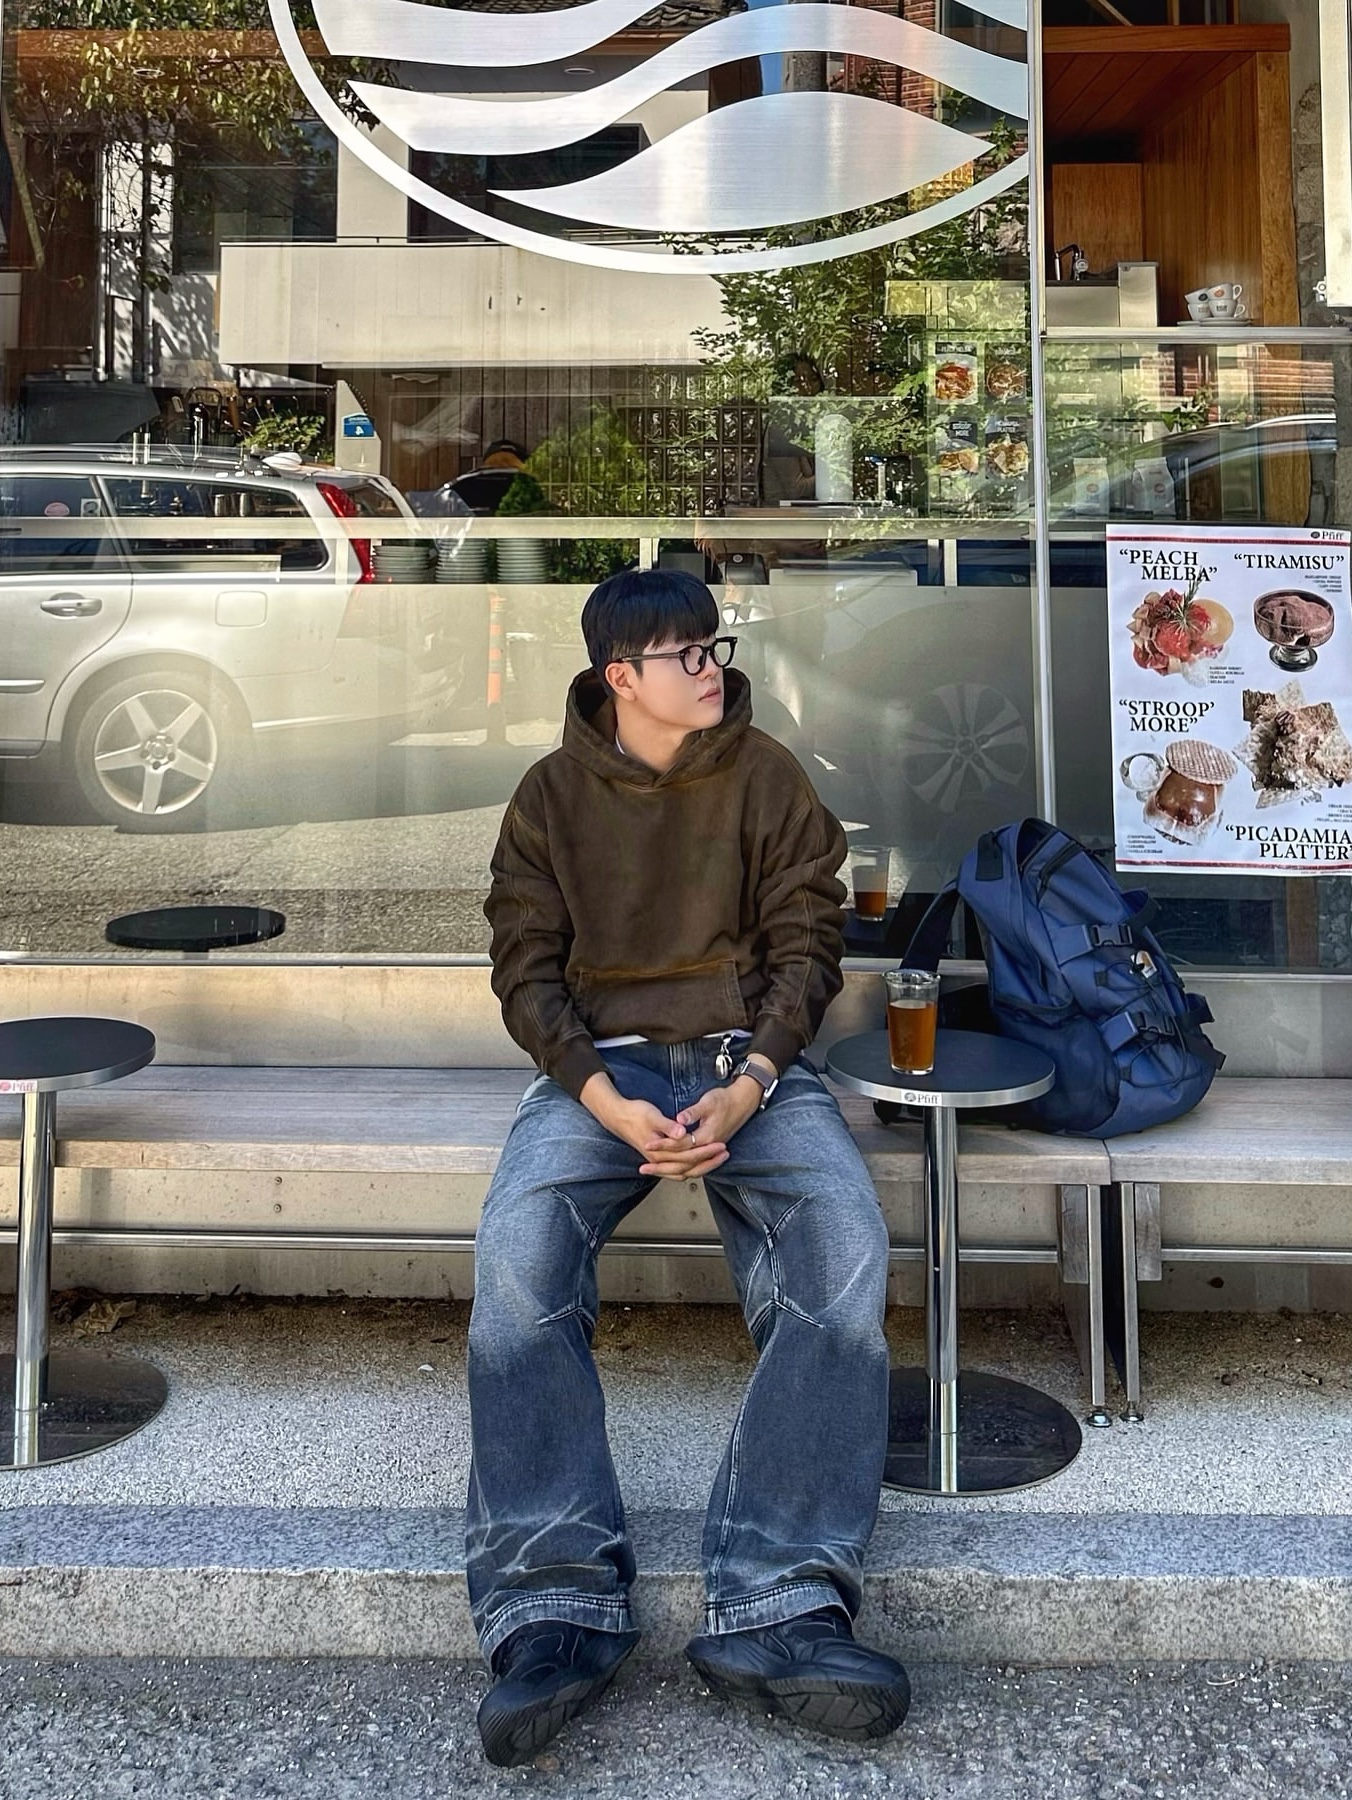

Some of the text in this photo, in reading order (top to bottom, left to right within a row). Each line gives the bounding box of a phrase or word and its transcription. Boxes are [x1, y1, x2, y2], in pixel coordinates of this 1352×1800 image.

[1119, 548, 1198, 566] “PEACH
[1234, 553, 1344, 570] “TIRAMISU”
[1141, 565, 1218, 582] MELBA”
[1130, 717, 1198, 733] MORE”
[1225, 824, 1352, 844] “PICADAMIA
